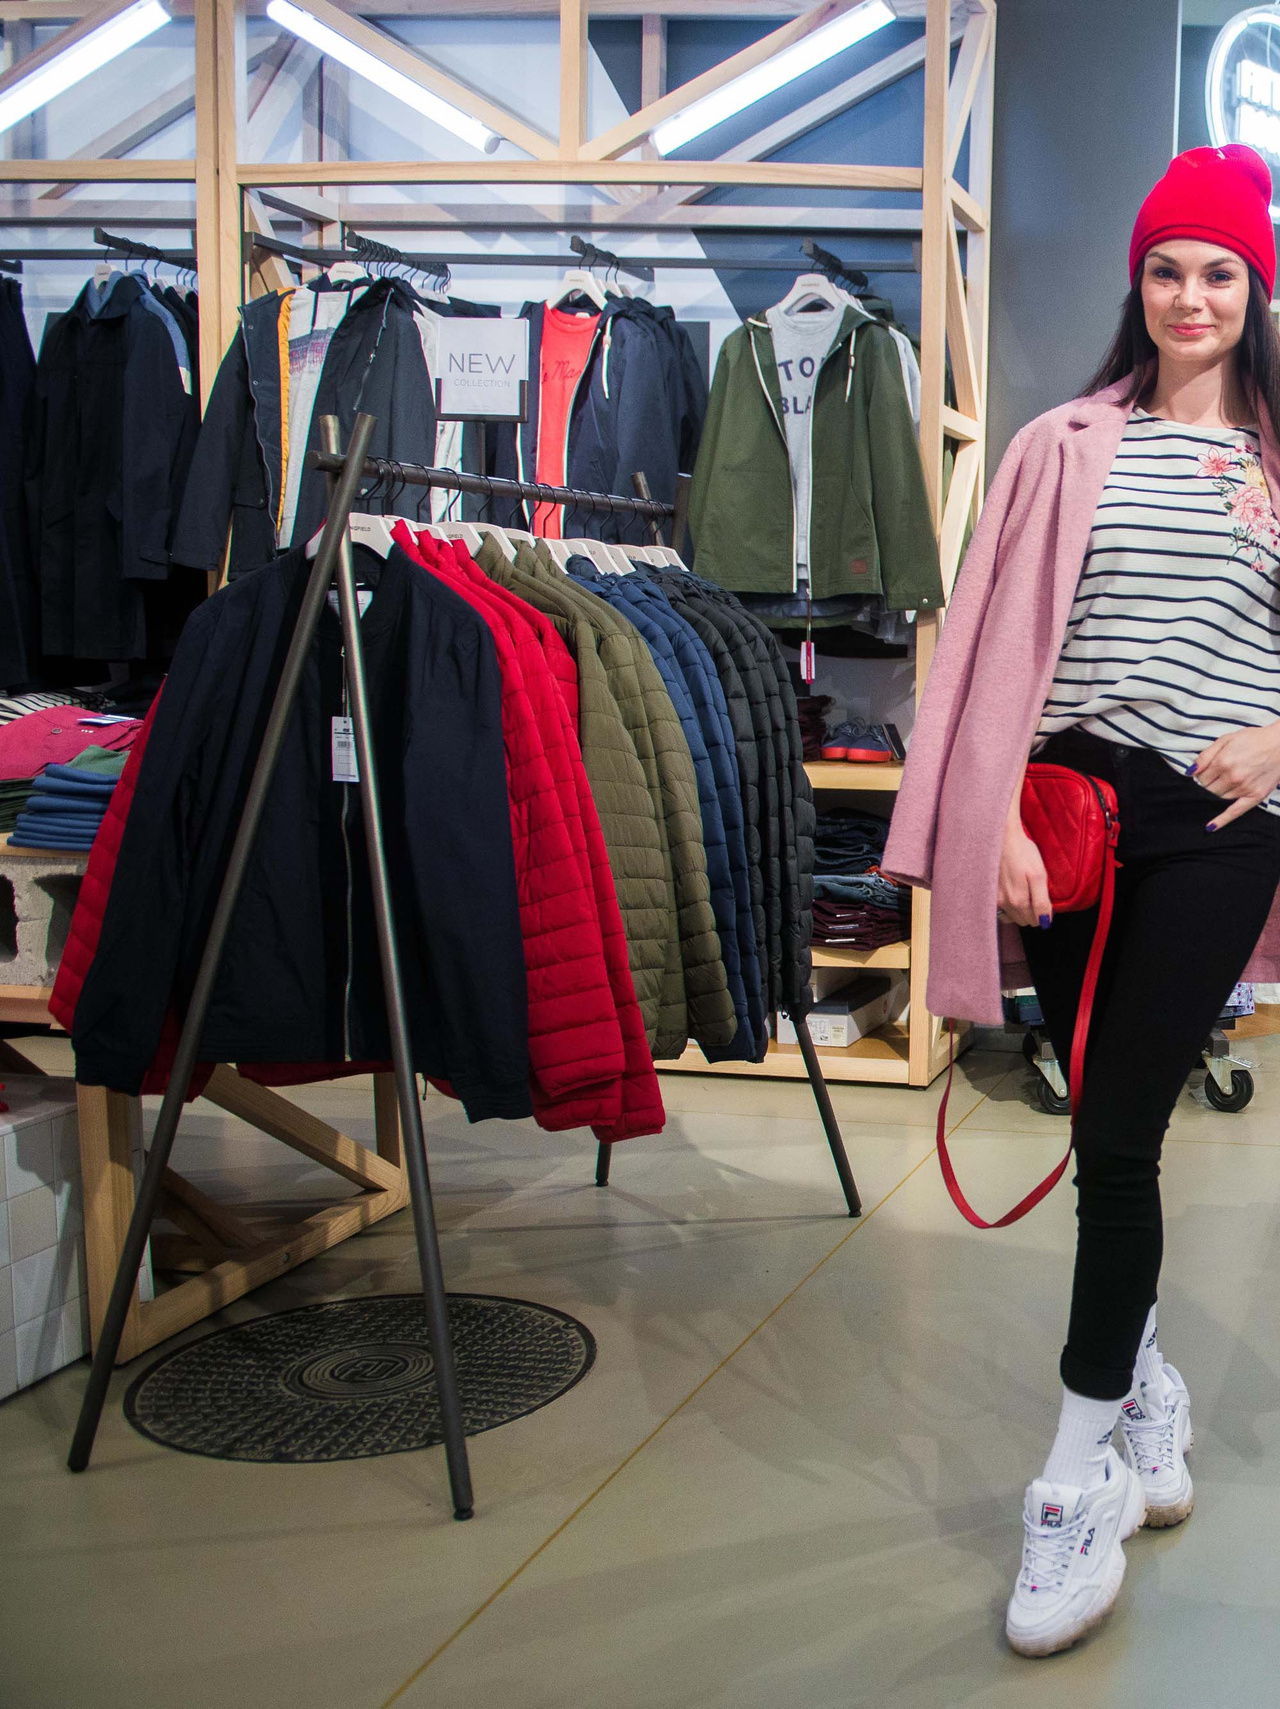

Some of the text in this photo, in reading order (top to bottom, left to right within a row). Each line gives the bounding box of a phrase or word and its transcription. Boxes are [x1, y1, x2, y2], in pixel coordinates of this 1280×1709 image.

[449, 353, 516, 374] NEW
[778, 356, 826, 381] TO
[453, 378, 511, 388] COLLECTION
[1080, 1527, 1095, 1556] FILA
